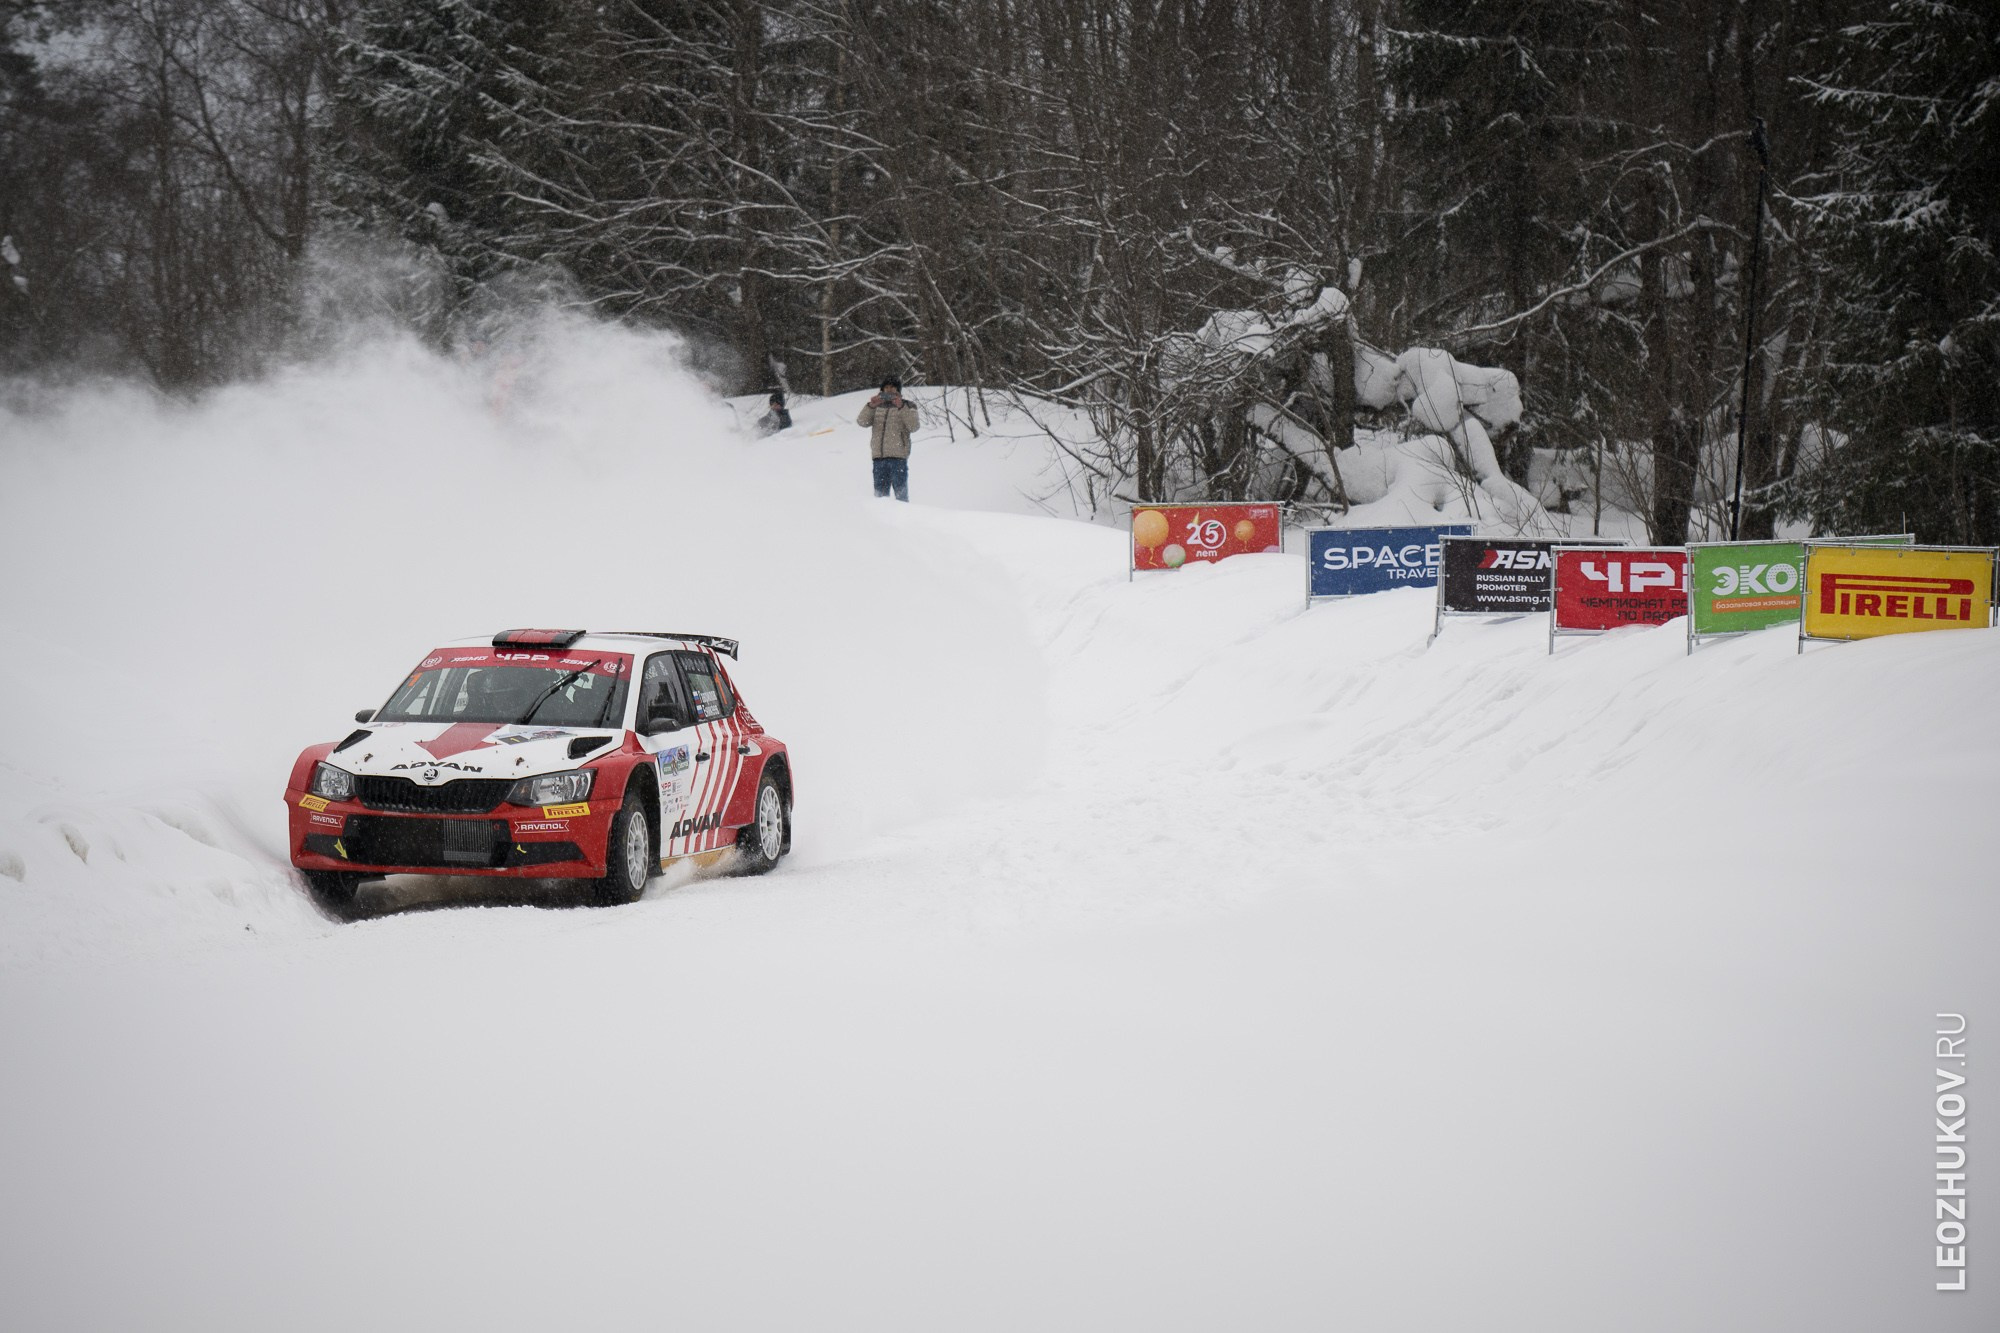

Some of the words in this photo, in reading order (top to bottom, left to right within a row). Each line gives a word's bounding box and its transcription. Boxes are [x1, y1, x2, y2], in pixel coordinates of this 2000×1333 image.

[1323, 544, 1441, 571] SPACE
[1489, 549, 1551, 570] ASM
[1476, 574, 1516, 583] RUSSIAN
[1517, 575, 1546, 583] RALLY
[1711, 562, 1804, 596] ЭКО
[1476, 583, 1527, 592] PROMOTER
[1581, 597, 1666, 609] ЧЕМПИОНАТ
[1671, 598, 1688, 609] РО
[1820, 573, 1975, 621] PIRELLI
[1617, 610, 1638, 621] ПО
[390, 761, 483, 773] ADVAN
[546, 805, 586, 817] PIRELLI
[520, 822, 565, 831] RAVENOL
[669, 811, 721, 840] ADVAN
